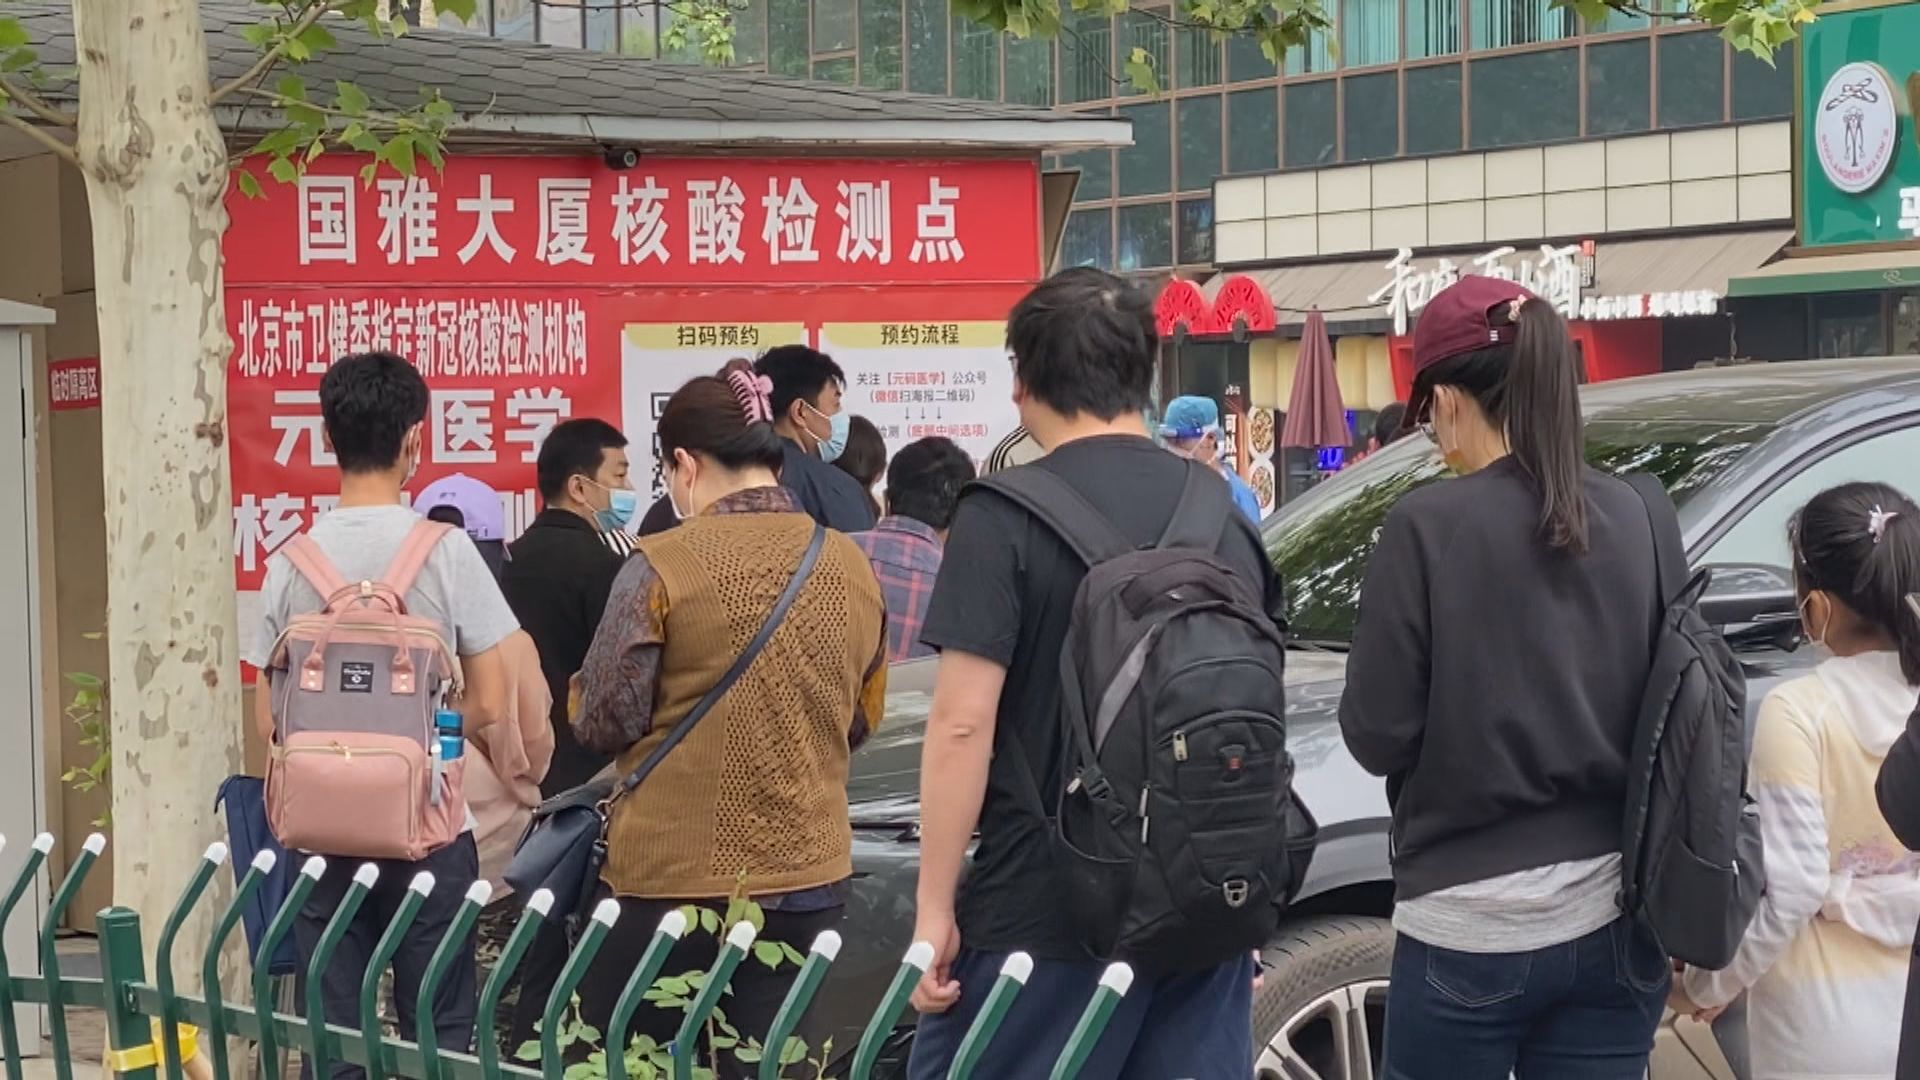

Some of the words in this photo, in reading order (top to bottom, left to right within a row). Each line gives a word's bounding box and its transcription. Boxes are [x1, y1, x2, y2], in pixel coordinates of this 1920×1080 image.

[299, 175, 965, 265] 国雅大厦核酸检测点
[238, 298, 587, 377] 北京市卫健委指定新冠核酸检测机构
[677, 324, 759, 346] 扫码预约
[881, 323, 960, 345] 预约流程
[270, 386, 571, 467] 元医学
